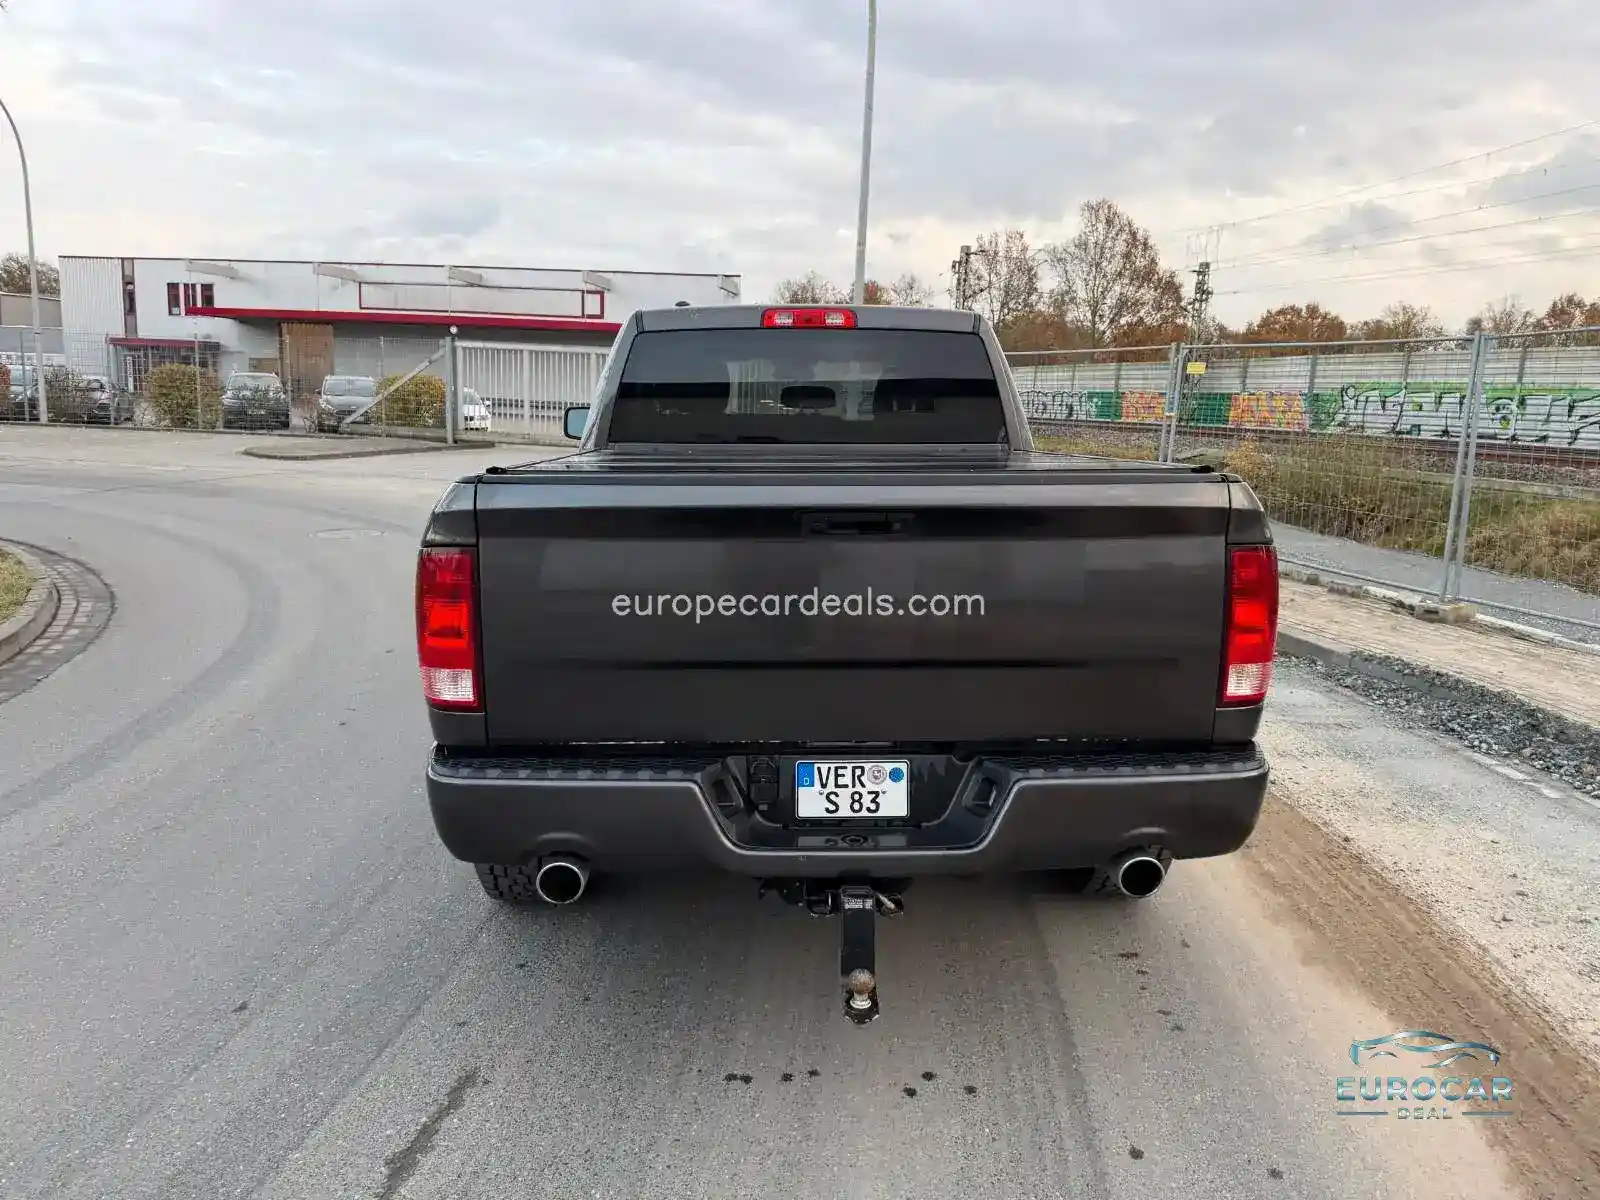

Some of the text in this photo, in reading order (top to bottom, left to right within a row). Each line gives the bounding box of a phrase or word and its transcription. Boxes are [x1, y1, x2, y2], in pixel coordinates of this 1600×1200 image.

[817, 765, 867, 789] VER
[824, 790, 881, 814] S 83
